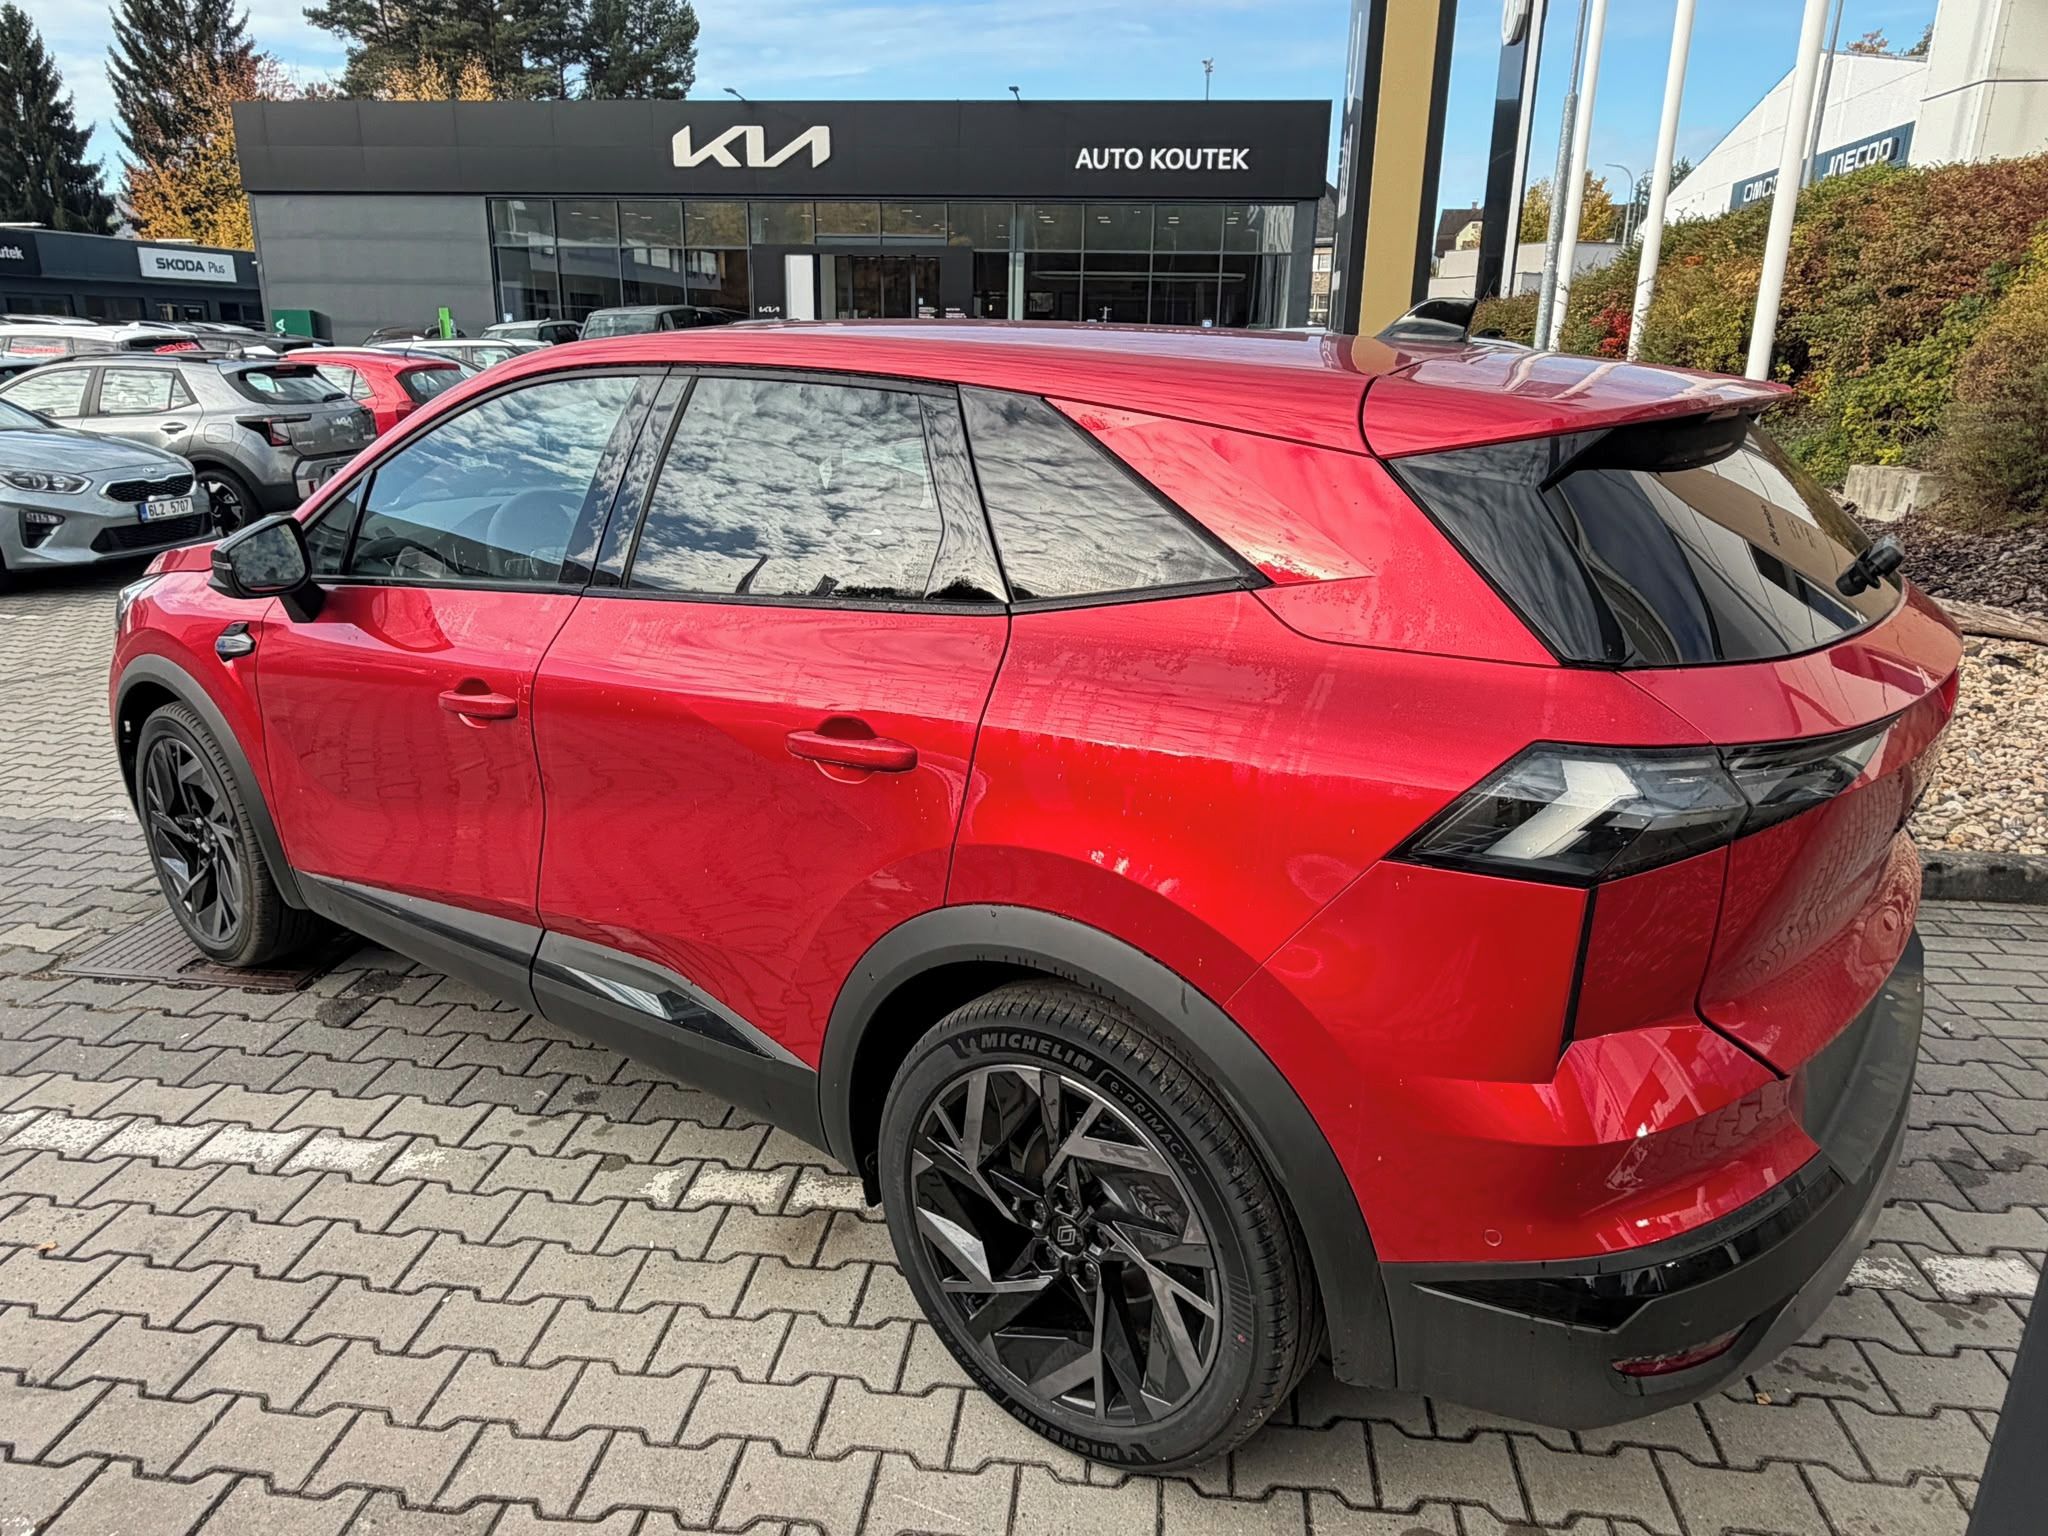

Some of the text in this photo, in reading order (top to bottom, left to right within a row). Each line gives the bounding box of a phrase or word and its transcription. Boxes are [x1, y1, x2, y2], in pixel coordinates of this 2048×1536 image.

[672, 125, 831, 168] KIA
[1075, 148, 1250, 170] AUTO KOUTEK
[208, 261, 226, 274] Plus
[148, 499, 189, 517] 6L2 5707
[980, 1033, 1093, 1073] MICHELIN
[1010, 1404, 1119, 1461] MICHELIN
